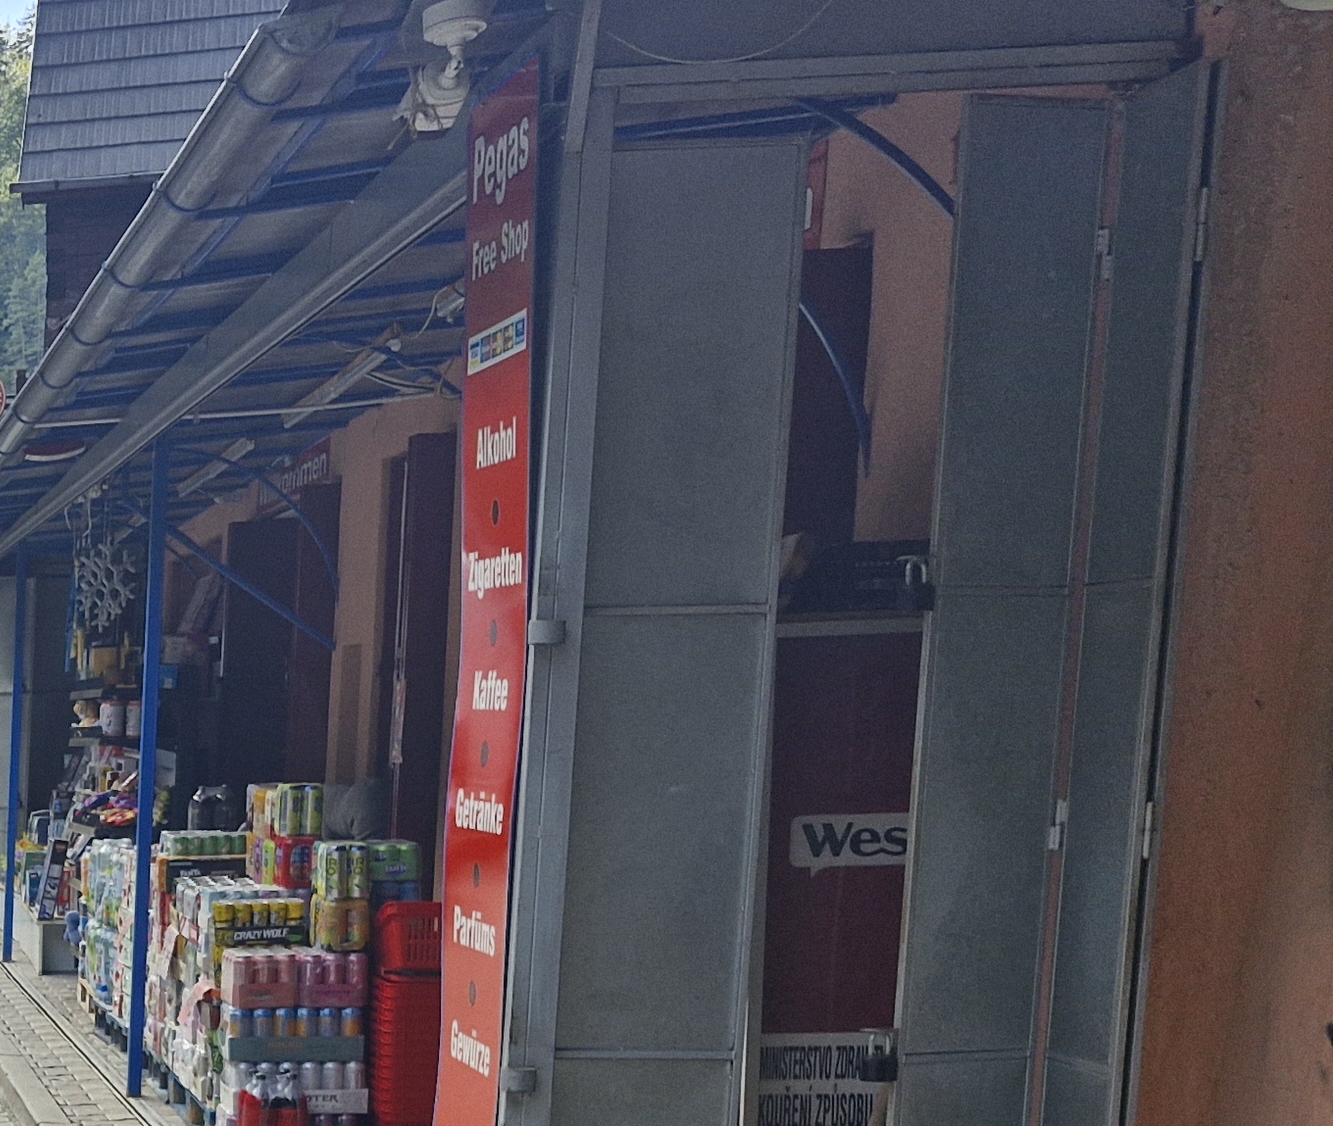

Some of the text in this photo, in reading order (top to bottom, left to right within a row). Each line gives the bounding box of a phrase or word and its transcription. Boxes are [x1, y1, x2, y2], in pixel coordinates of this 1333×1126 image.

[473, 116, 529, 205] Pegas
[472, 219, 529, 281] Free Shop
[476, 416, 516, 469] Alkohol
[468, 547, 523, 599] Zigaretten
[472, 670, 509, 711] Kaffee
[455, 788, 504, 835] Getränke
[234, 927, 289, 941] CRAZY WOLF
[453, 904, 495, 957] Parfüms
[450, 1019, 491, 1078] Gewürze
[760, 1045, 832, 1080] MINISTERSTVO
